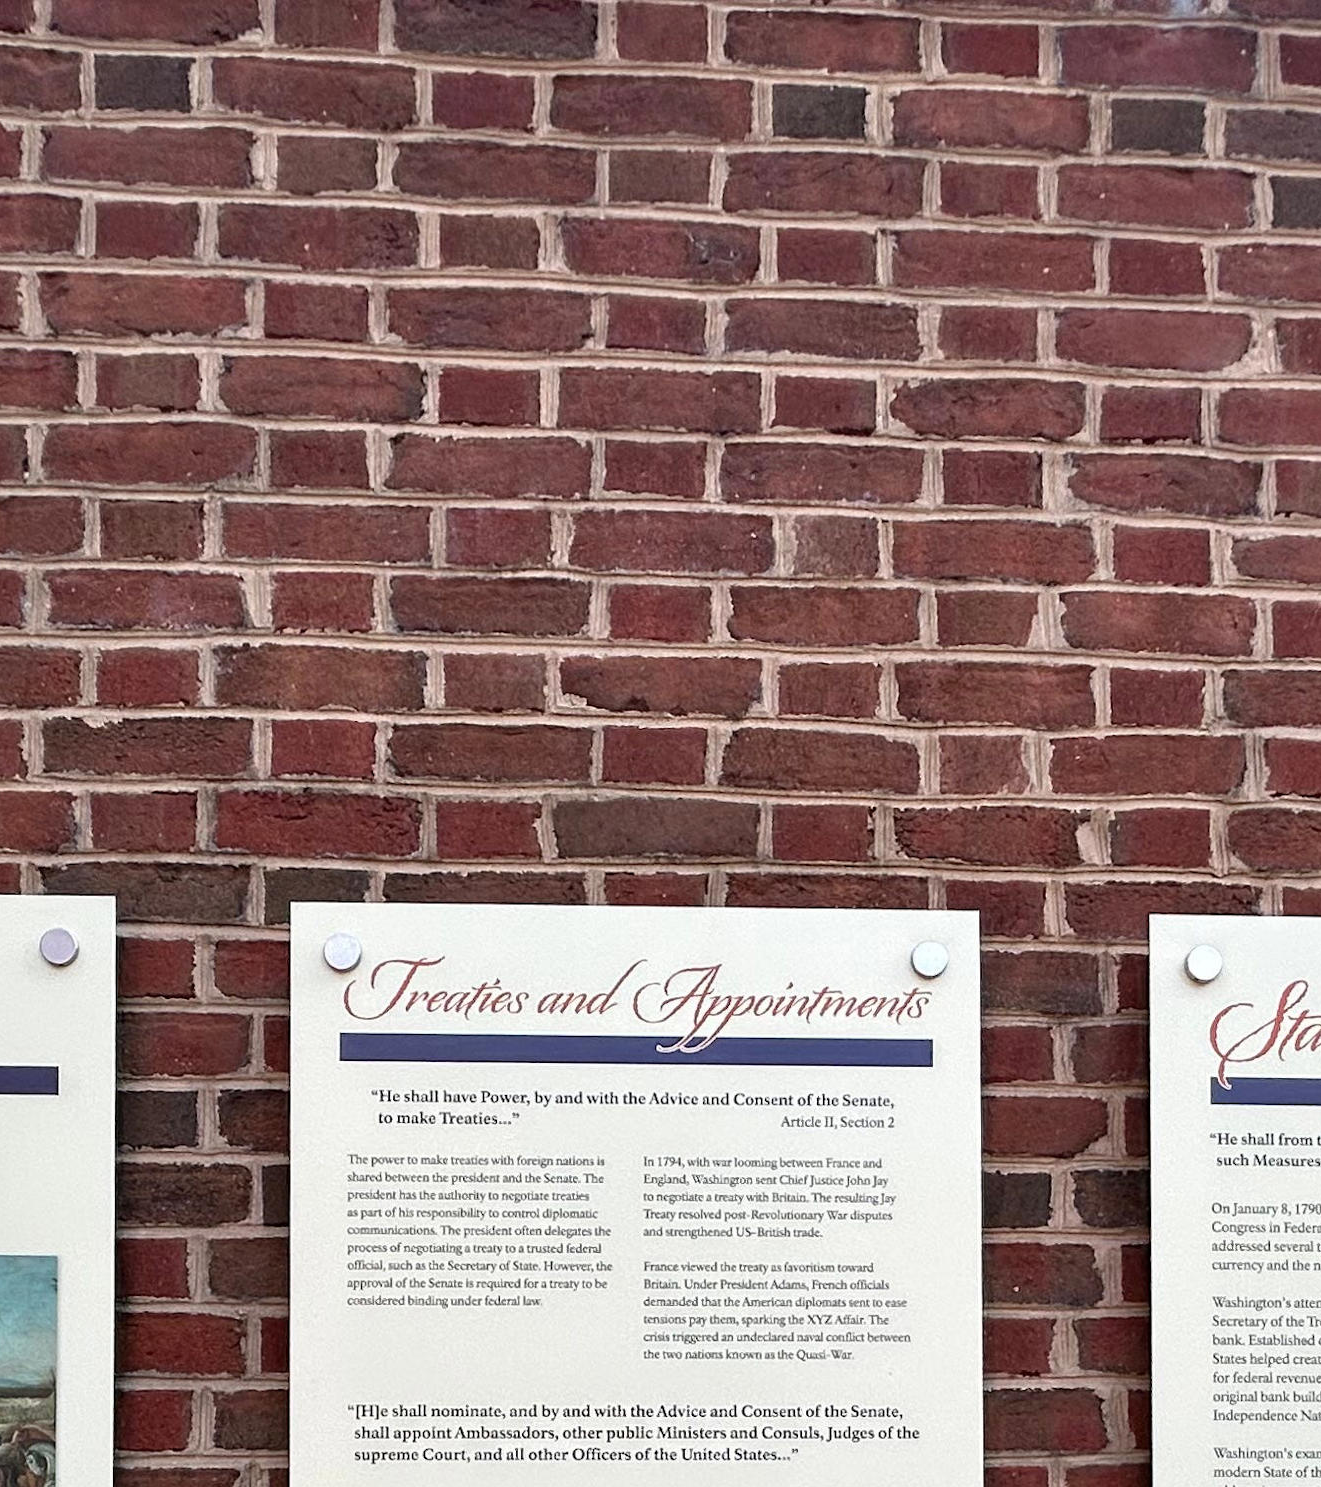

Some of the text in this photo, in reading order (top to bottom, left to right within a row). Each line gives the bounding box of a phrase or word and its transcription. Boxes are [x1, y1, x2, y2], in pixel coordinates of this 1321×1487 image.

[343, 956, 932, 1053] Treaties and Appointments
[404, 1089, 439, 1103] shall
[443, 1090, 477, 1103] have
[481, 1090, 530, 1106] Power,
[534, 1091, 552, 1108] by
[555, 1091, 583, 1104] and
[586, 1091, 619, 1105] with
[623, 1091, 646, 1105] the
[649, 1092, 699, 1106] Advice
[702, 1092, 730, 1106] and
[733, 1093, 793, 1106] Consent
[797, 1093, 814, 1107] of
[816, 1093, 839, 1107] the
[842, 1094, 894, 1109] Senate,
[378, 1113, 393, 1124] to
[397, 1111, 436, 1125] make
[781, 1116, 895, 1130] Article II, Section 2
[1241, 1132, 1275, 1146] shall
[1278, 1132, 1313, 1146] from
[1216, 1153, 1249, 1167] such
[1253, 1154, 1321, 1167] Measures
[346, 1295, 543, 1309] considered binding under federal law.
[392, 1404, 427, 1417] shall
[431, 1404, 506, 1419] nominate,
[509, 1404, 538, 1418] and
[542, 1404, 559, 1421] by
[562, 1404, 591, 1418] and
[594, 1404, 627, 1418] with
[630, 1404, 654, 1418] the
[656, 1404, 706, 1418] Advice
[710, 1404, 738, 1418] and
[741, 1405, 802, 1418] Consent
[805, 1404, 822, 1418] of
[824, 1404, 848, 1418] the
[851, 1405, 903, 1420] Senate,
[1213, 1409, 1298, 1425] Independence
[354, 1425, 920, 1443] shall appoint Ambassadors, other public Ministers and Consuls, Judges of the
[354, 1451, 419, 1465] supreme
[422, 1448, 471, 1463] Court,
[474, 1447, 503, 1461] and
[506, 1447, 524, 1461] all
[528, 1448, 569, 1461] other
[572, 1447, 632, 1461] Officers
[635, 1447, 652, 1461] of
[654, 1447, 677, 1461] the
[681, 1447, 731, 1461] United
